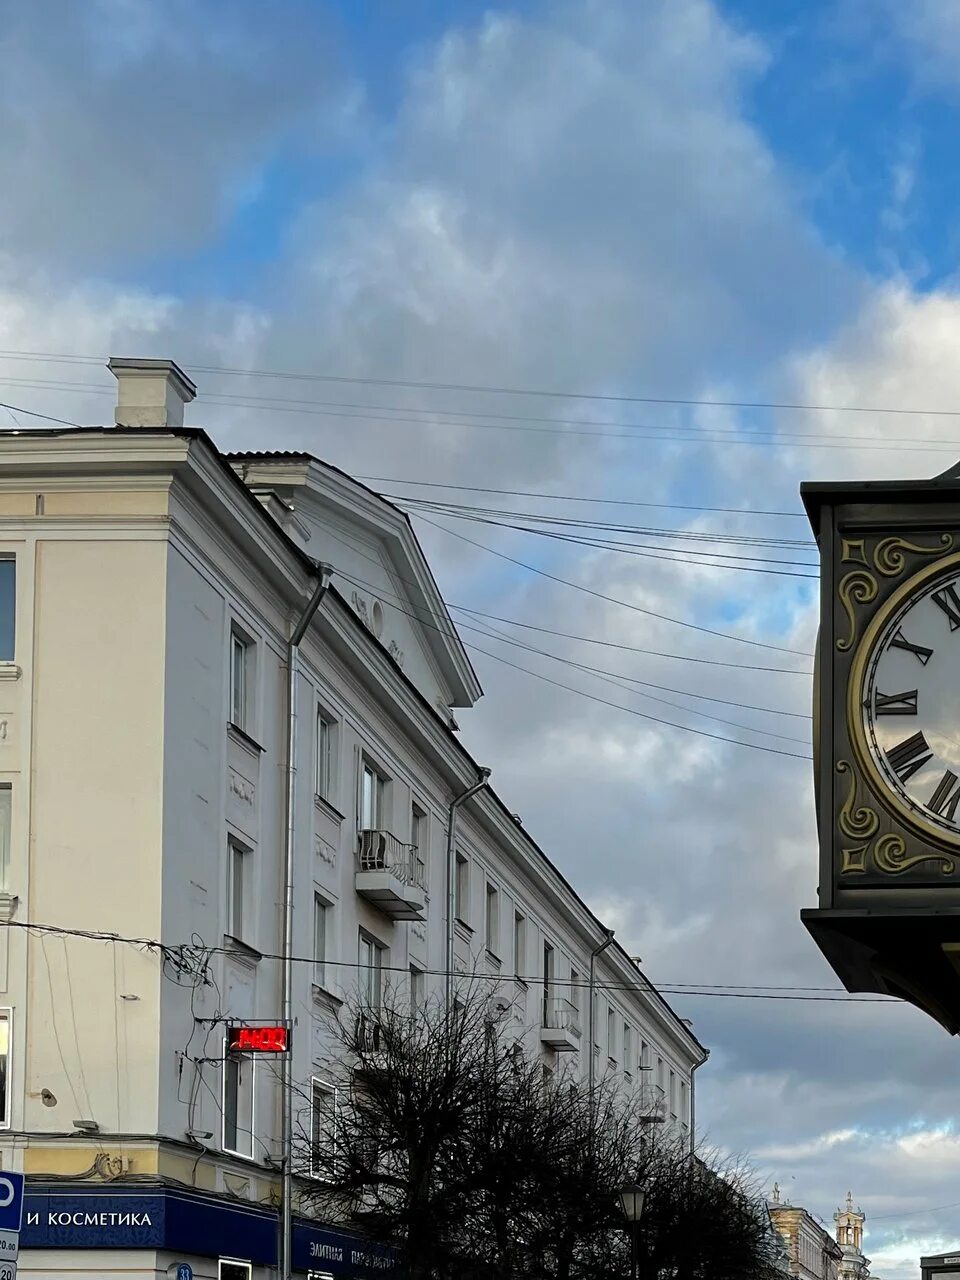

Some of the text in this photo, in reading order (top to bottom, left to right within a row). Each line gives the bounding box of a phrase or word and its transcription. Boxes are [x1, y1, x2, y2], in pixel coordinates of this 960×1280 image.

[887, 626, 934, 666] X
[875, 686, 918, 719] IX
[27, 1212, 152, 1225] И КОСМЕТИКА
[310, 1242, 343, 1261] ЭЛИТНАЯ
